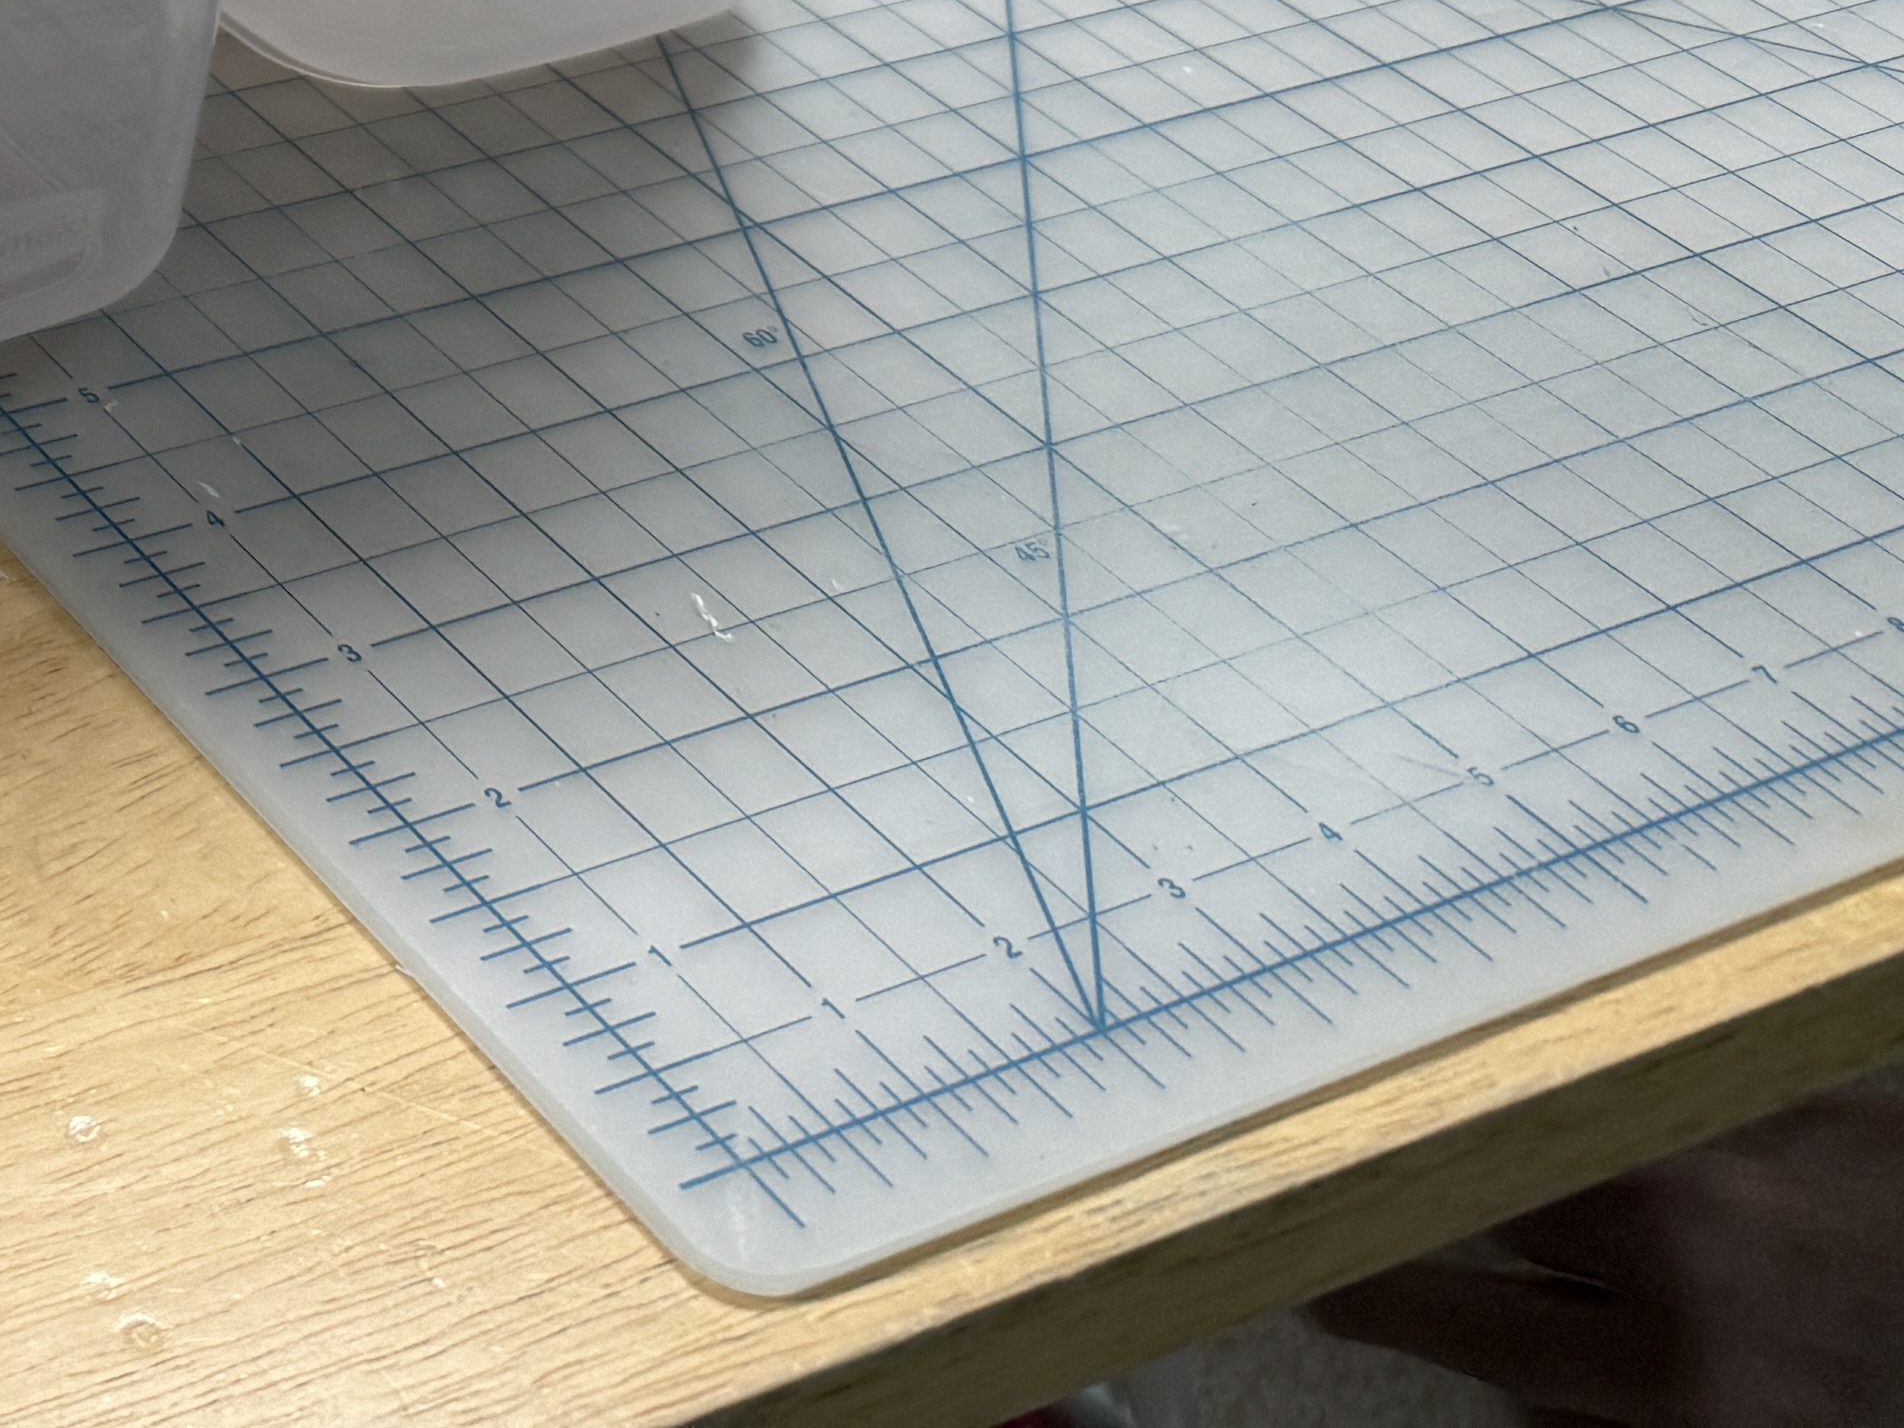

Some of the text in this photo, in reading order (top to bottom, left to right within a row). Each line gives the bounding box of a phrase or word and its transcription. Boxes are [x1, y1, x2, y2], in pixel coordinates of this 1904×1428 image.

[78, 387, 101, 405] 5
[204, 510, 225, 528] 4
[339, 643, 362, 662] 3
[1751, 665, 1778, 684] 7
[1613, 714, 1640, 734] 6
[1469, 767, 1494, 786] 5
[485, 787, 512, 809] 2
[1319, 822, 1343, 841] 4
[1158, 878, 1188, 901] 3
[648, 945, 672, 968] 1
[993, 935, 1025, 960] 2
[821, 997, 846, 1020] 1
